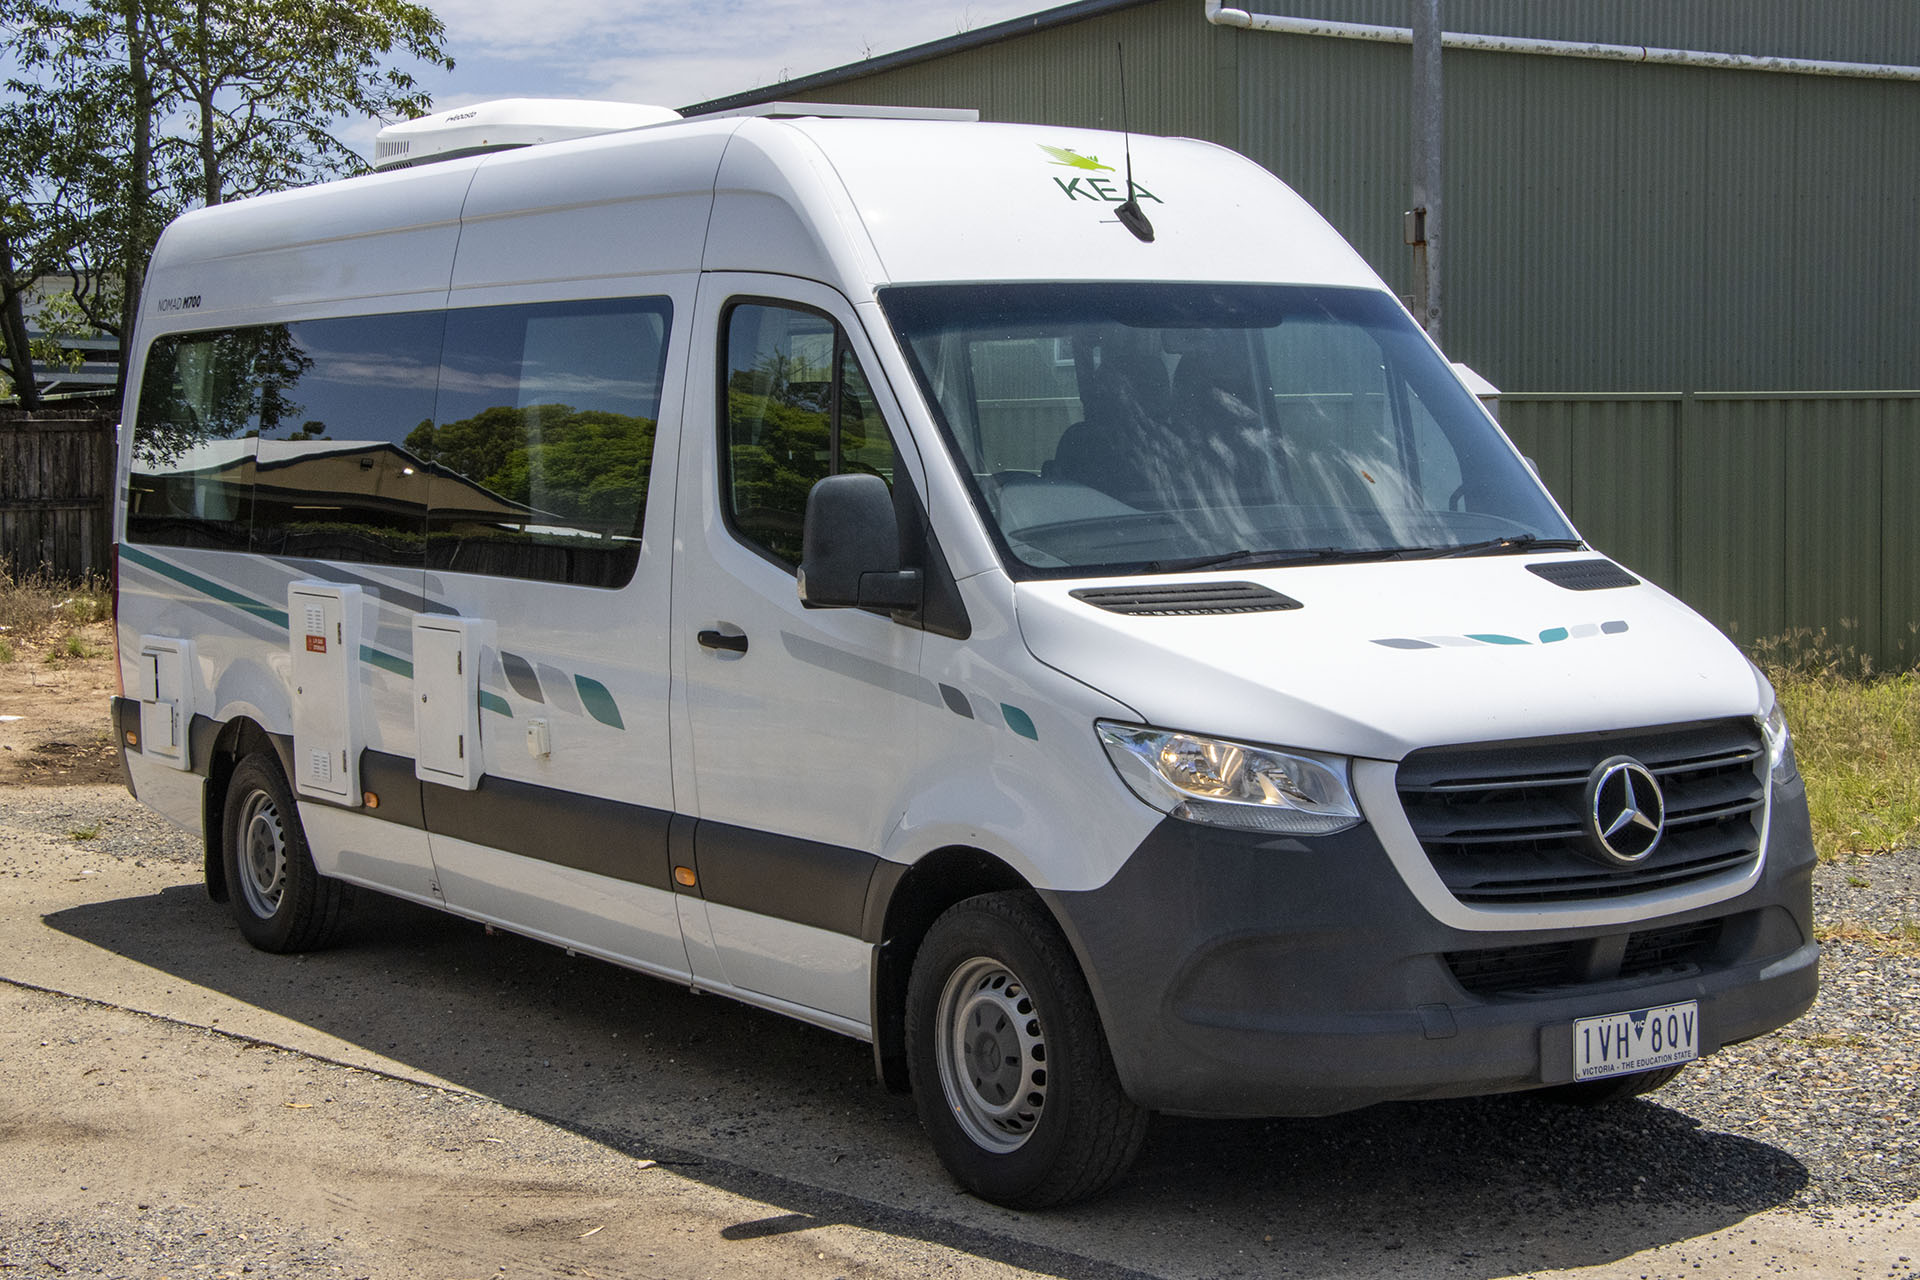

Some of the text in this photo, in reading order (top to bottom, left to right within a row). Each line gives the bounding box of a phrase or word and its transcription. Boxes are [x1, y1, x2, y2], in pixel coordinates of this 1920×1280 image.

[1053, 176, 1165, 204] KEA
[157, 294, 202, 312] NOMAD M700
[1584, 1011, 1694, 1064] 1VH 8QV
[1582, 1063, 1615, 1076] VICTORIA
[1621, 1060, 1635, 1070] THE
[1636, 1054, 1673, 1067] EDUCATION
[1674, 1050, 1692, 1061] STATE
